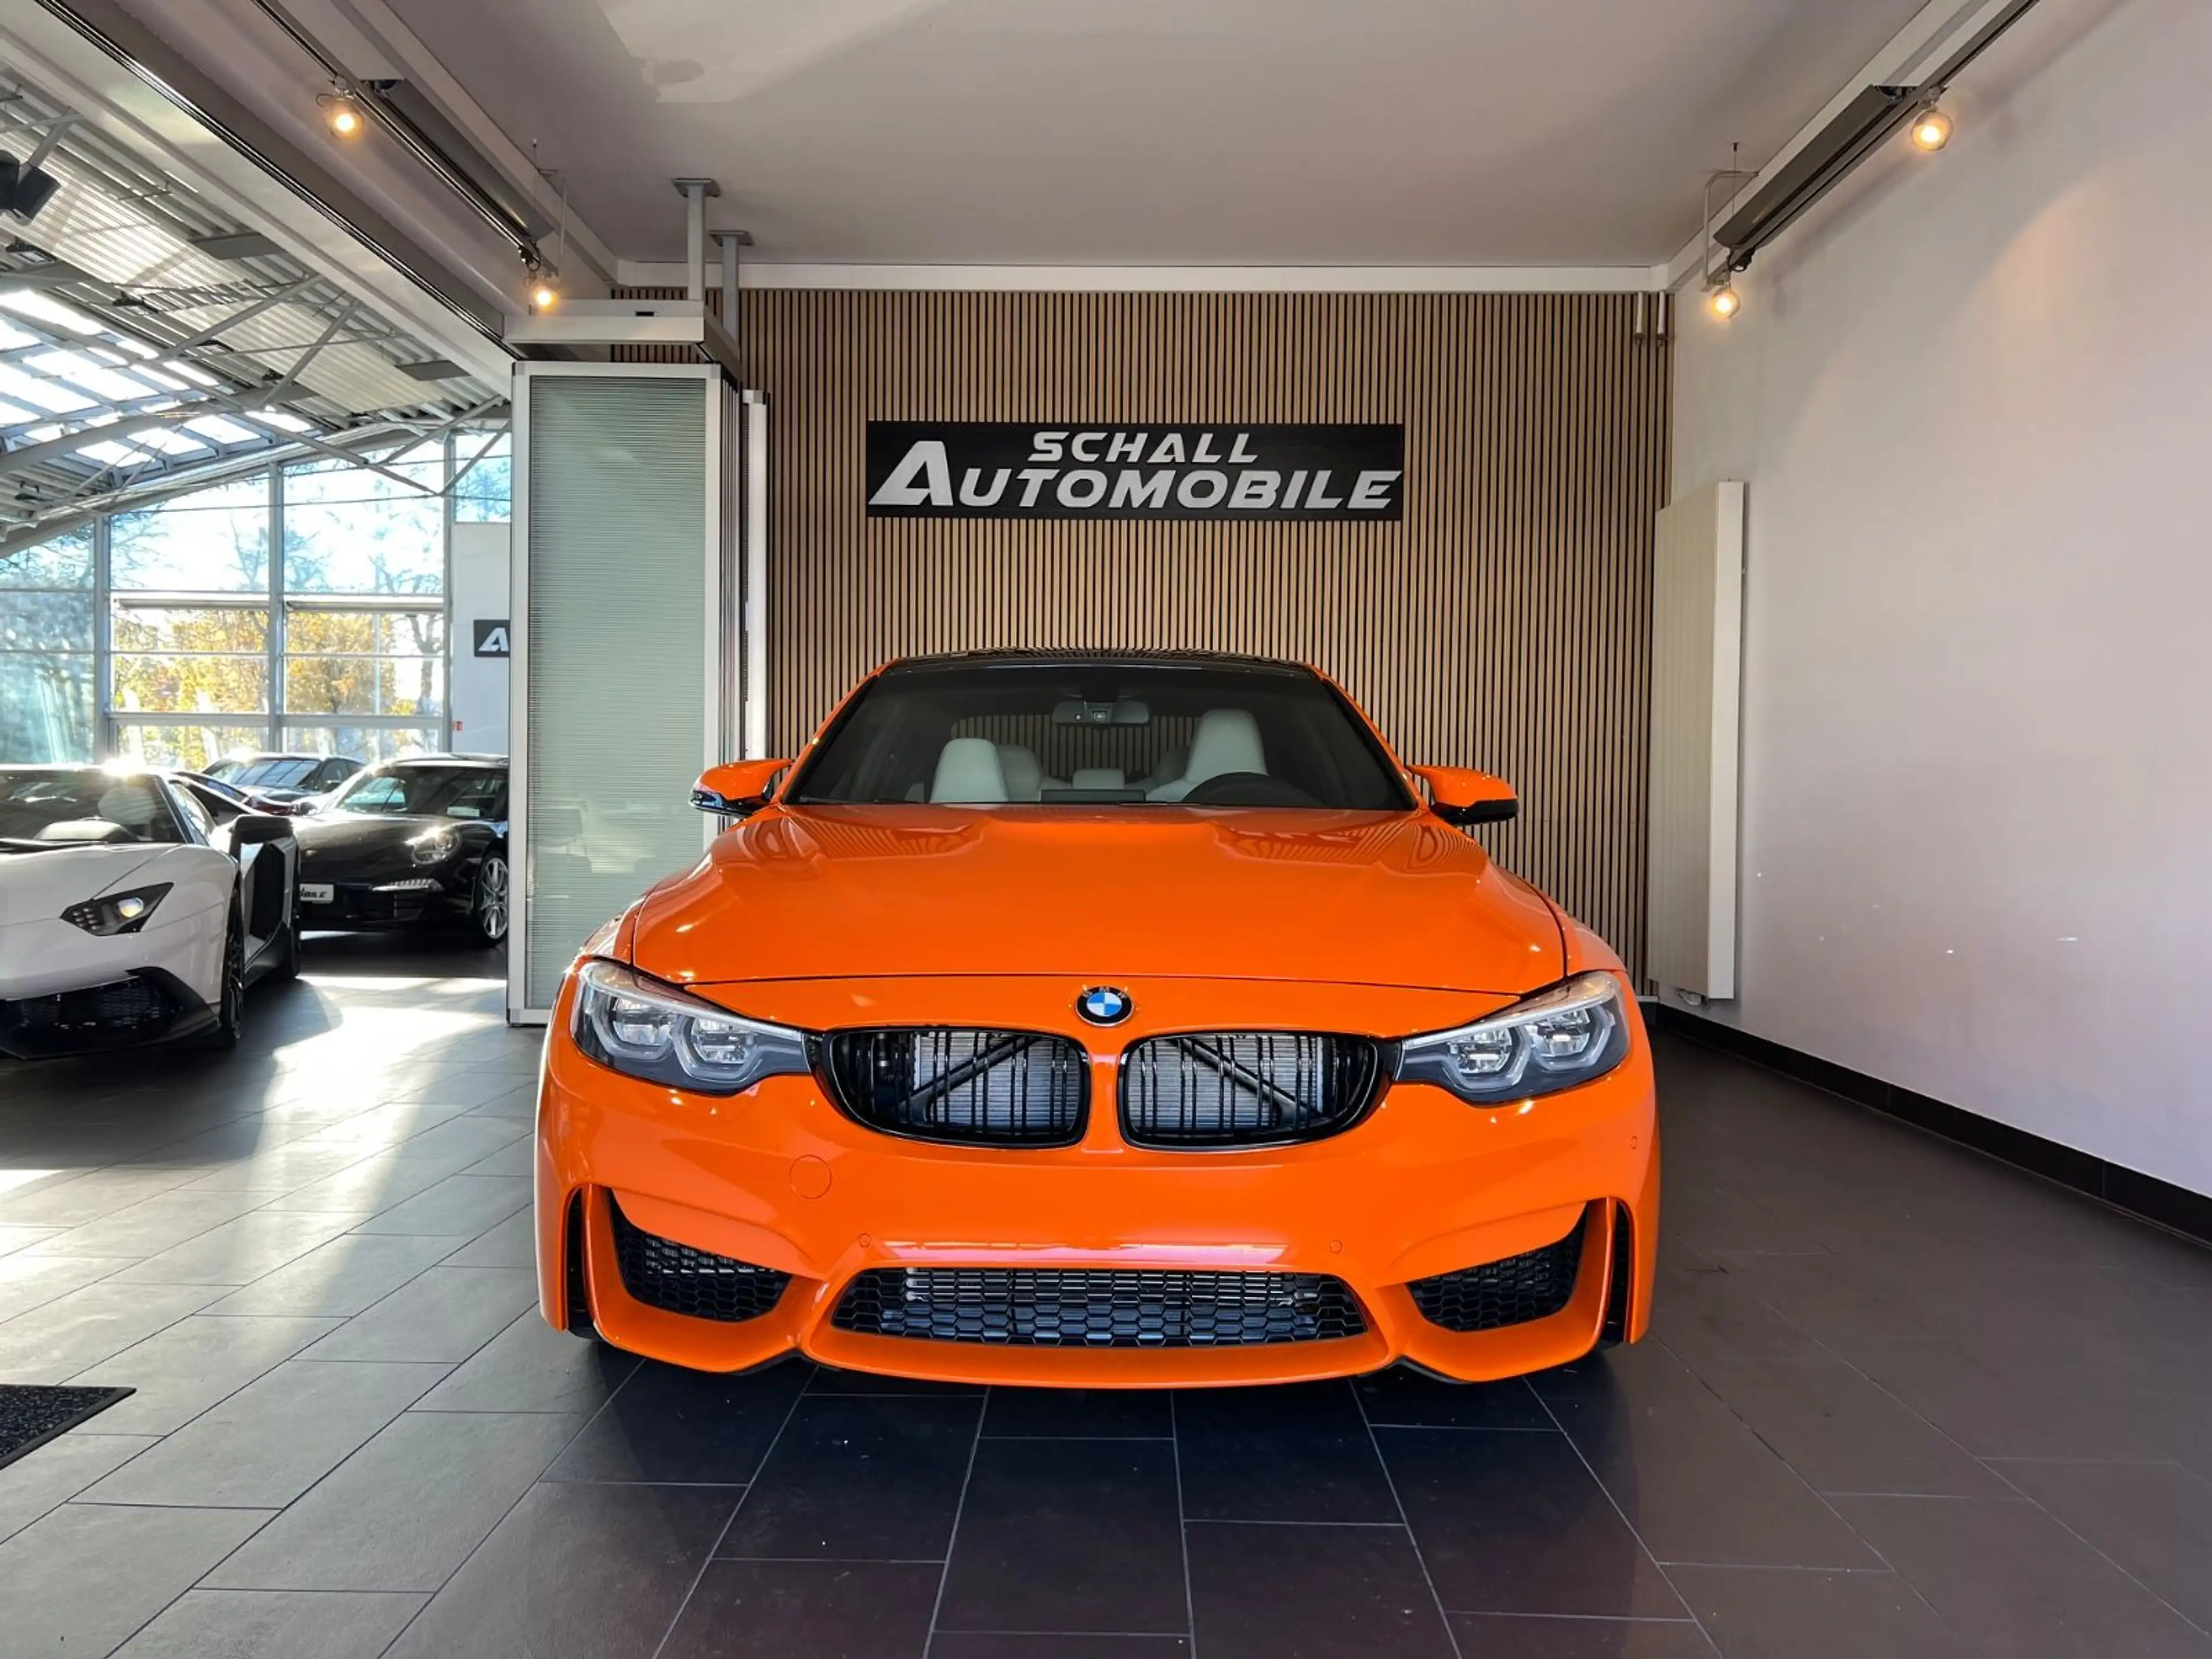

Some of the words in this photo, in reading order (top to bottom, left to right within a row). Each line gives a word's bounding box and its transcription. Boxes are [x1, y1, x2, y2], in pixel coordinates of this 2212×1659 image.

[1028, 431, 1258, 463] SCHALL
[869, 441, 1402, 509] AUTOMOBILE
[478, 627, 509, 652] A
